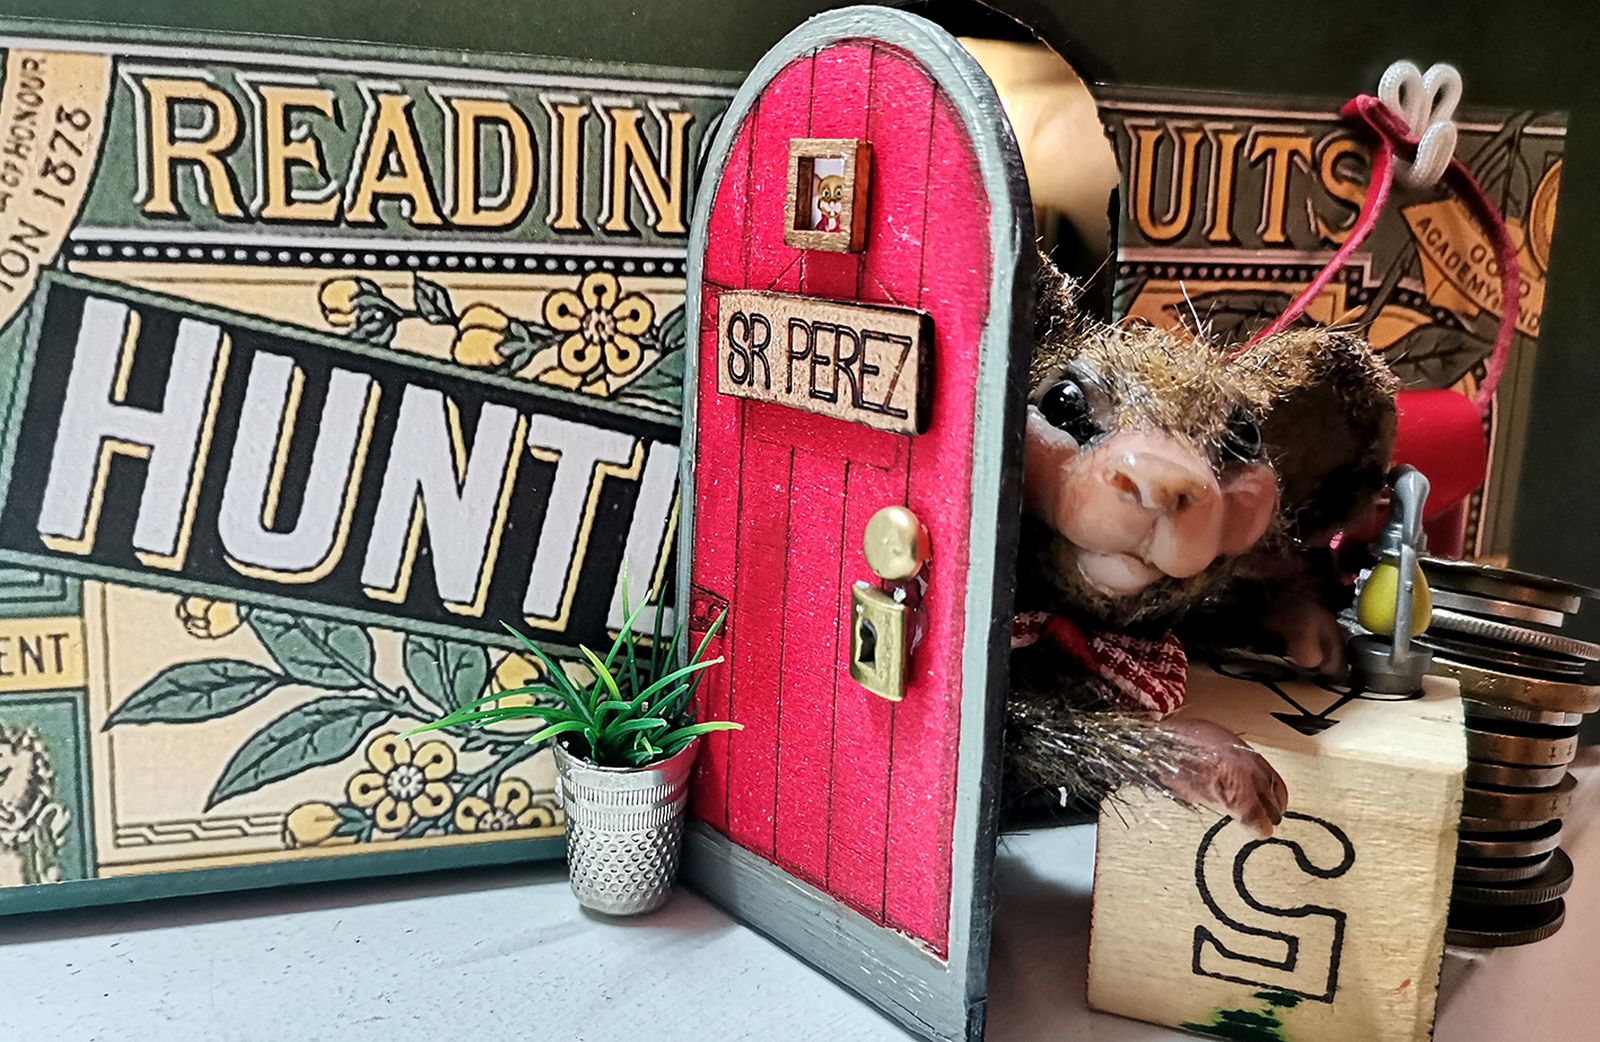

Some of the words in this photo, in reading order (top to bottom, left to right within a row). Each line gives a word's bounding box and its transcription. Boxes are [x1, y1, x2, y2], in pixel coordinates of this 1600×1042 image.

[33, 105, 92, 207] 1878
[121, 72, 700, 235] READIN
[1127, 119, 1368, 246] UITS
[1416, 217, 1497, 301] ACADEMY
[727, 311, 771, 390] SR
[785, 317, 912, 420] PEREZ
[1192, 811, 1356, 1004] 5
